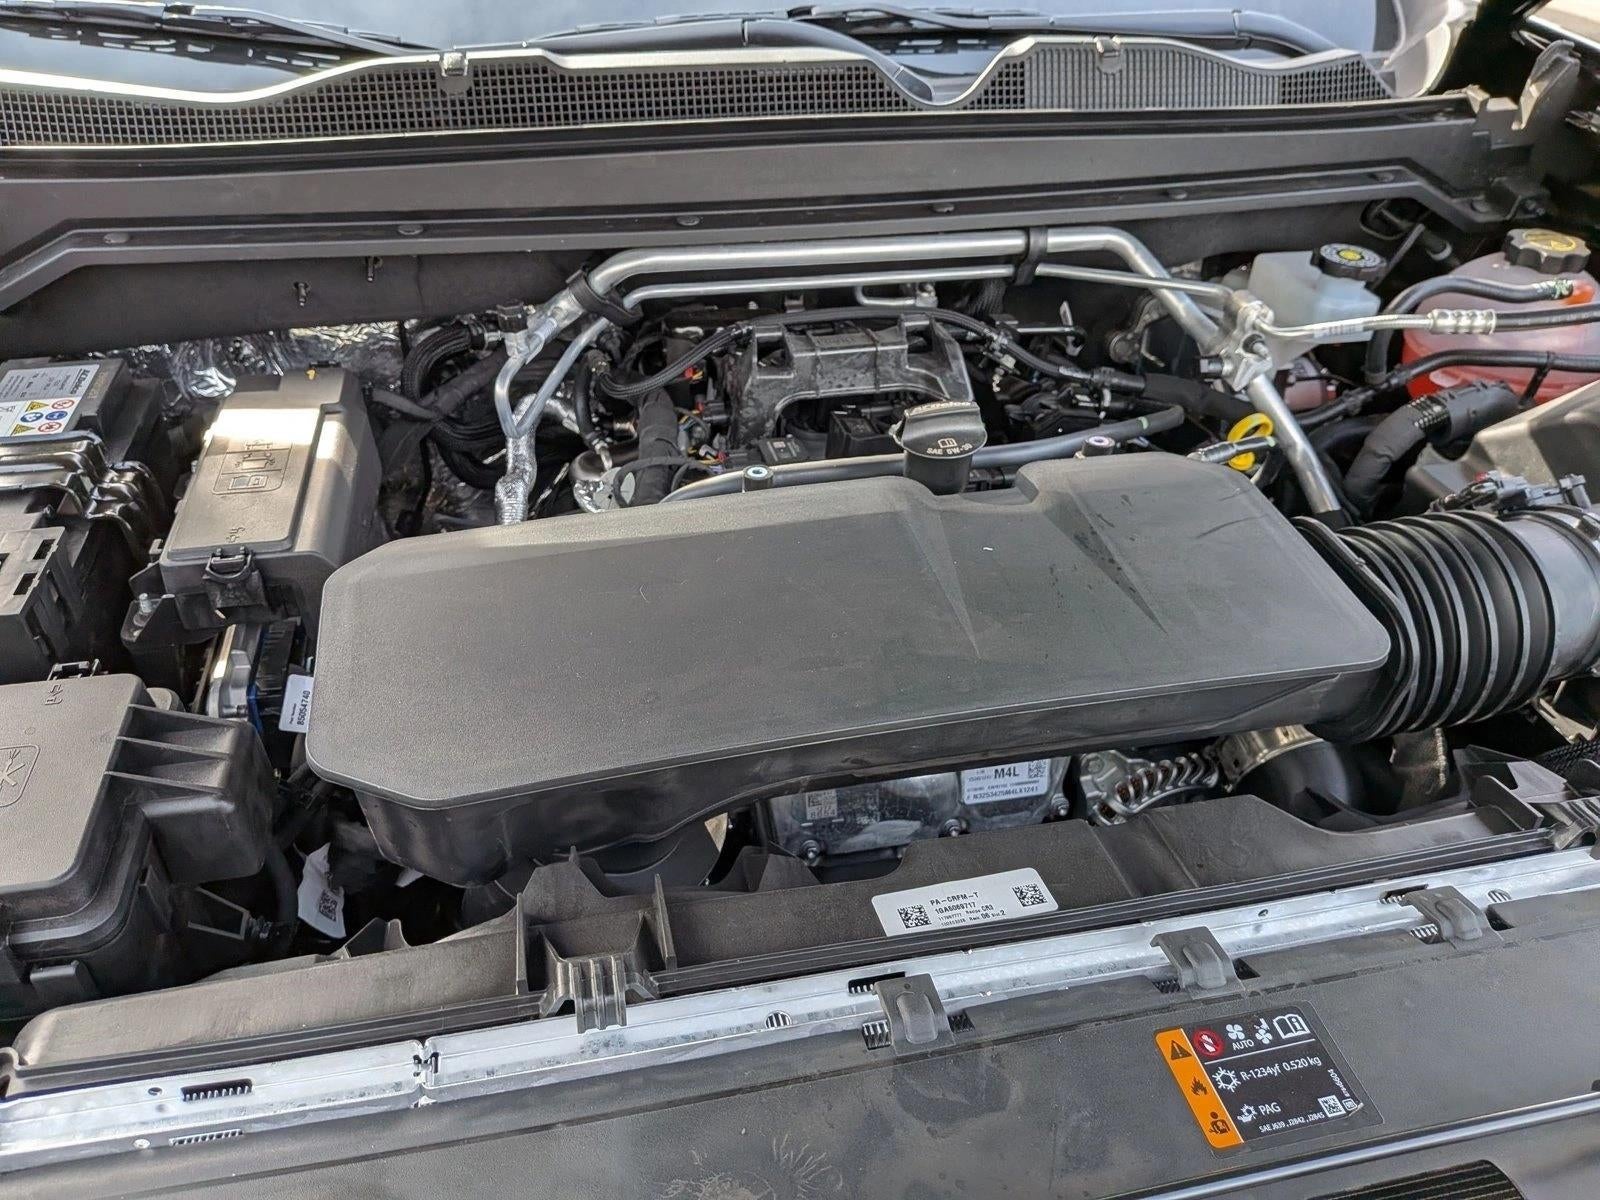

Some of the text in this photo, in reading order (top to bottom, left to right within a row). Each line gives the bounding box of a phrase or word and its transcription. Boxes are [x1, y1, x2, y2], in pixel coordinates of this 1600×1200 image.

[926, 447, 944, 455] SAE
[994, 766, 1020, 780] M4L
[930, 891, 979, 906] PA-CRFM-T
[1232, 1039, 1255, 1051] AUTO
[1240, 1056, 1322, 1081] R-1234yf 0.520 kg
[1258, 1102, 1282, 1116] PAG
[1258, 1124, 1272, 1133] SAE
